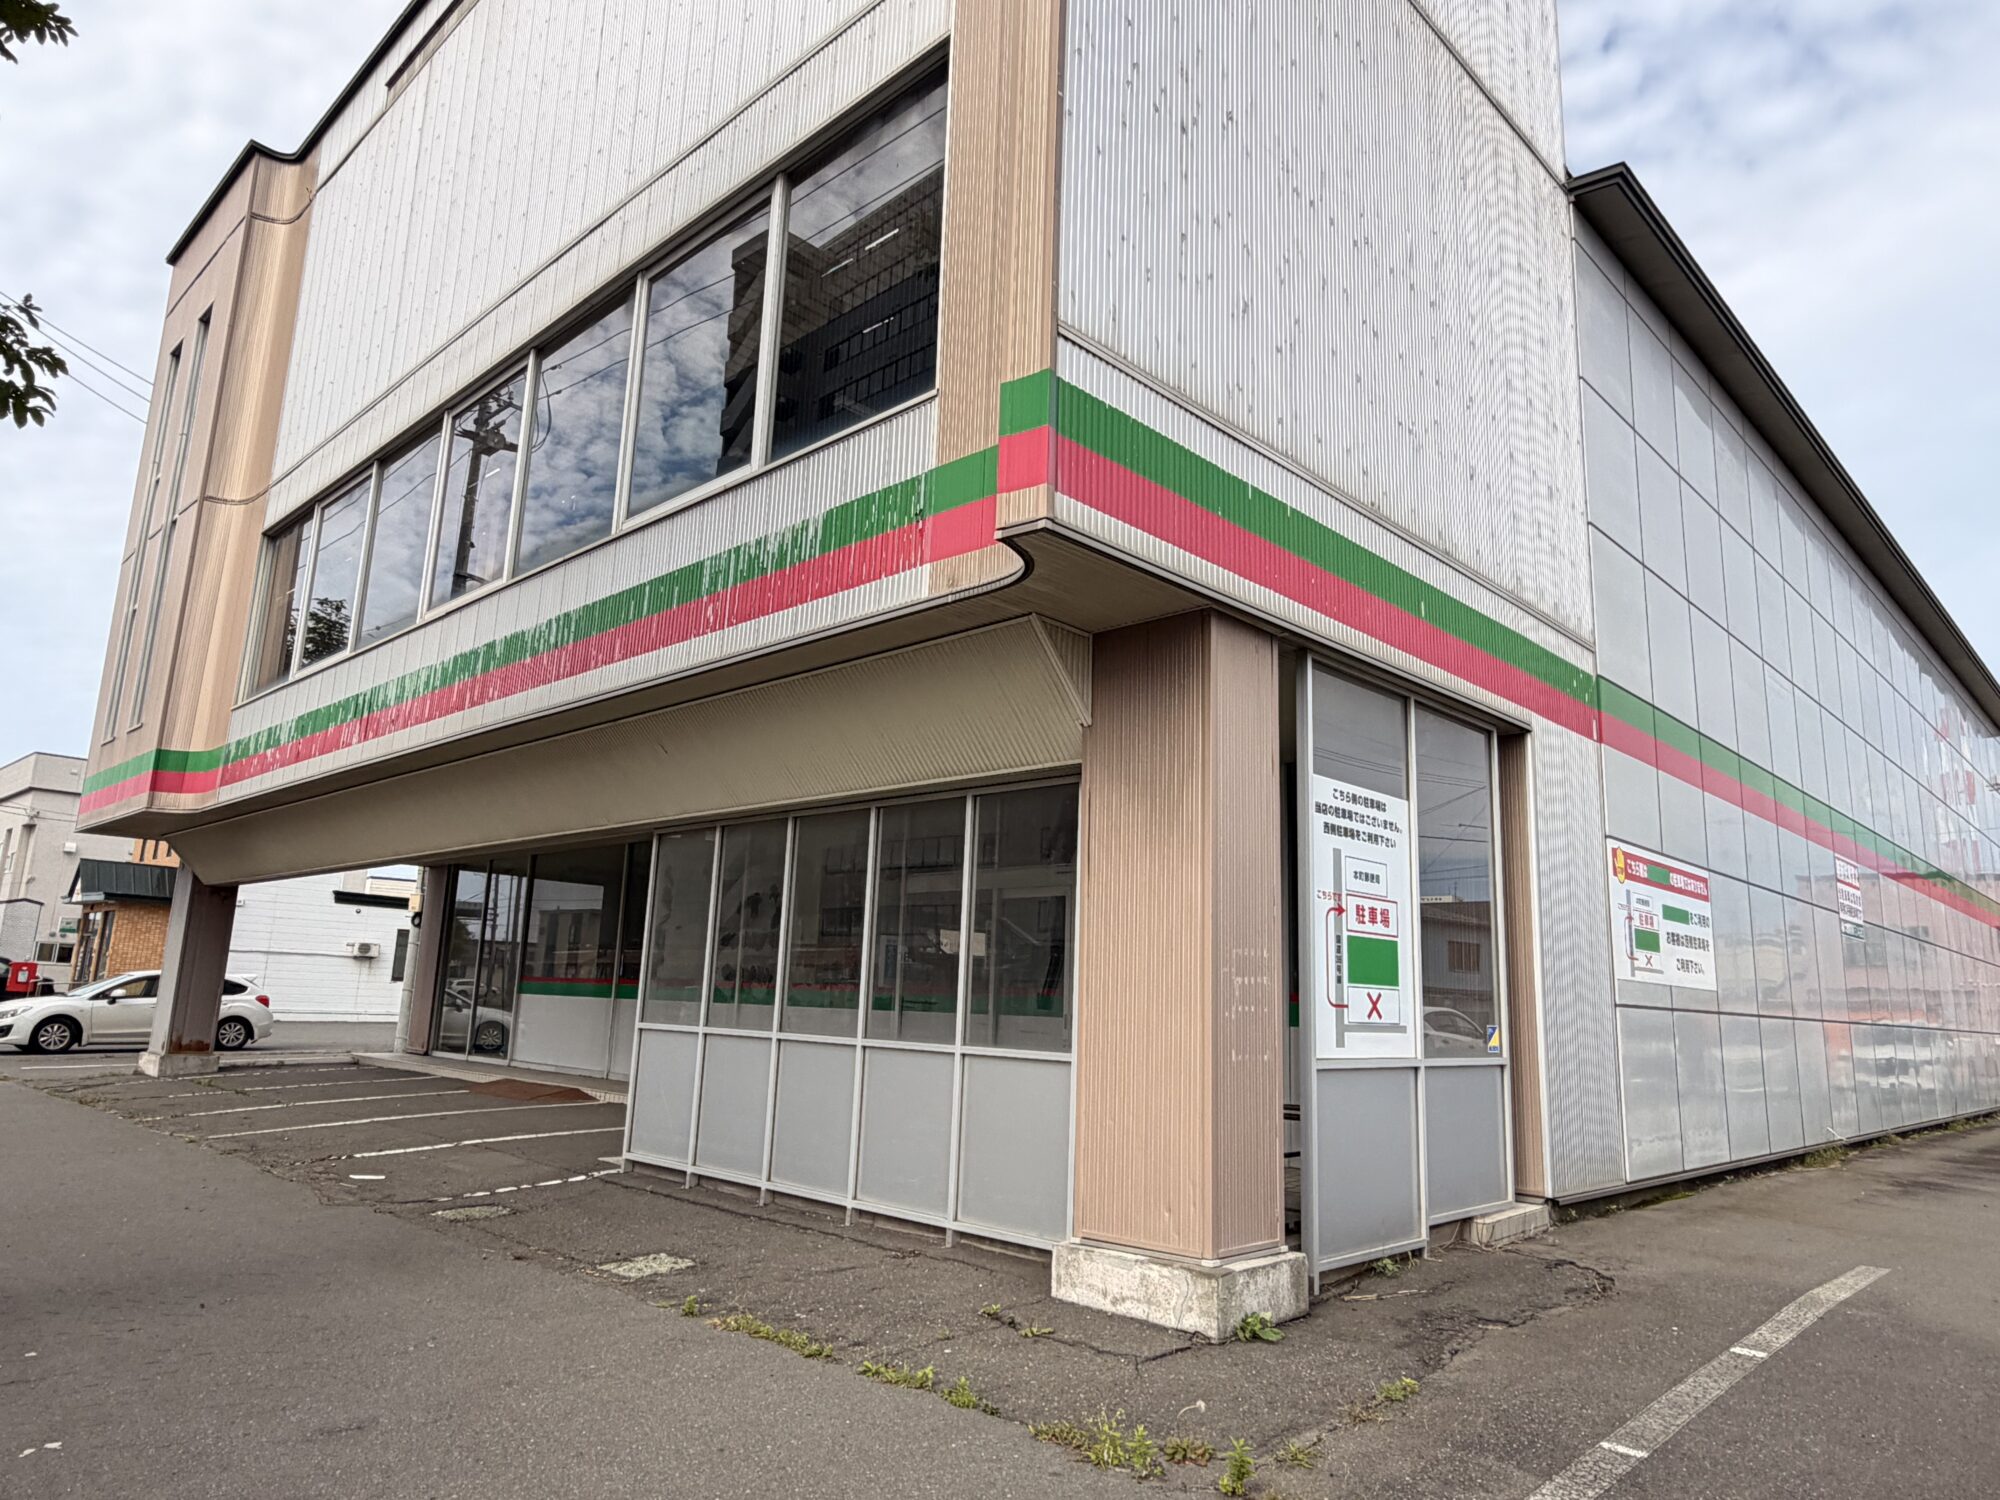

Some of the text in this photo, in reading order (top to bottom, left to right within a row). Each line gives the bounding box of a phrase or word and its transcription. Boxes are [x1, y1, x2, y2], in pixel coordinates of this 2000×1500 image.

[1333, 788, 1387, 813] こちら側の駐車場は
[1355, 903, 1391, 929] 駐車場
